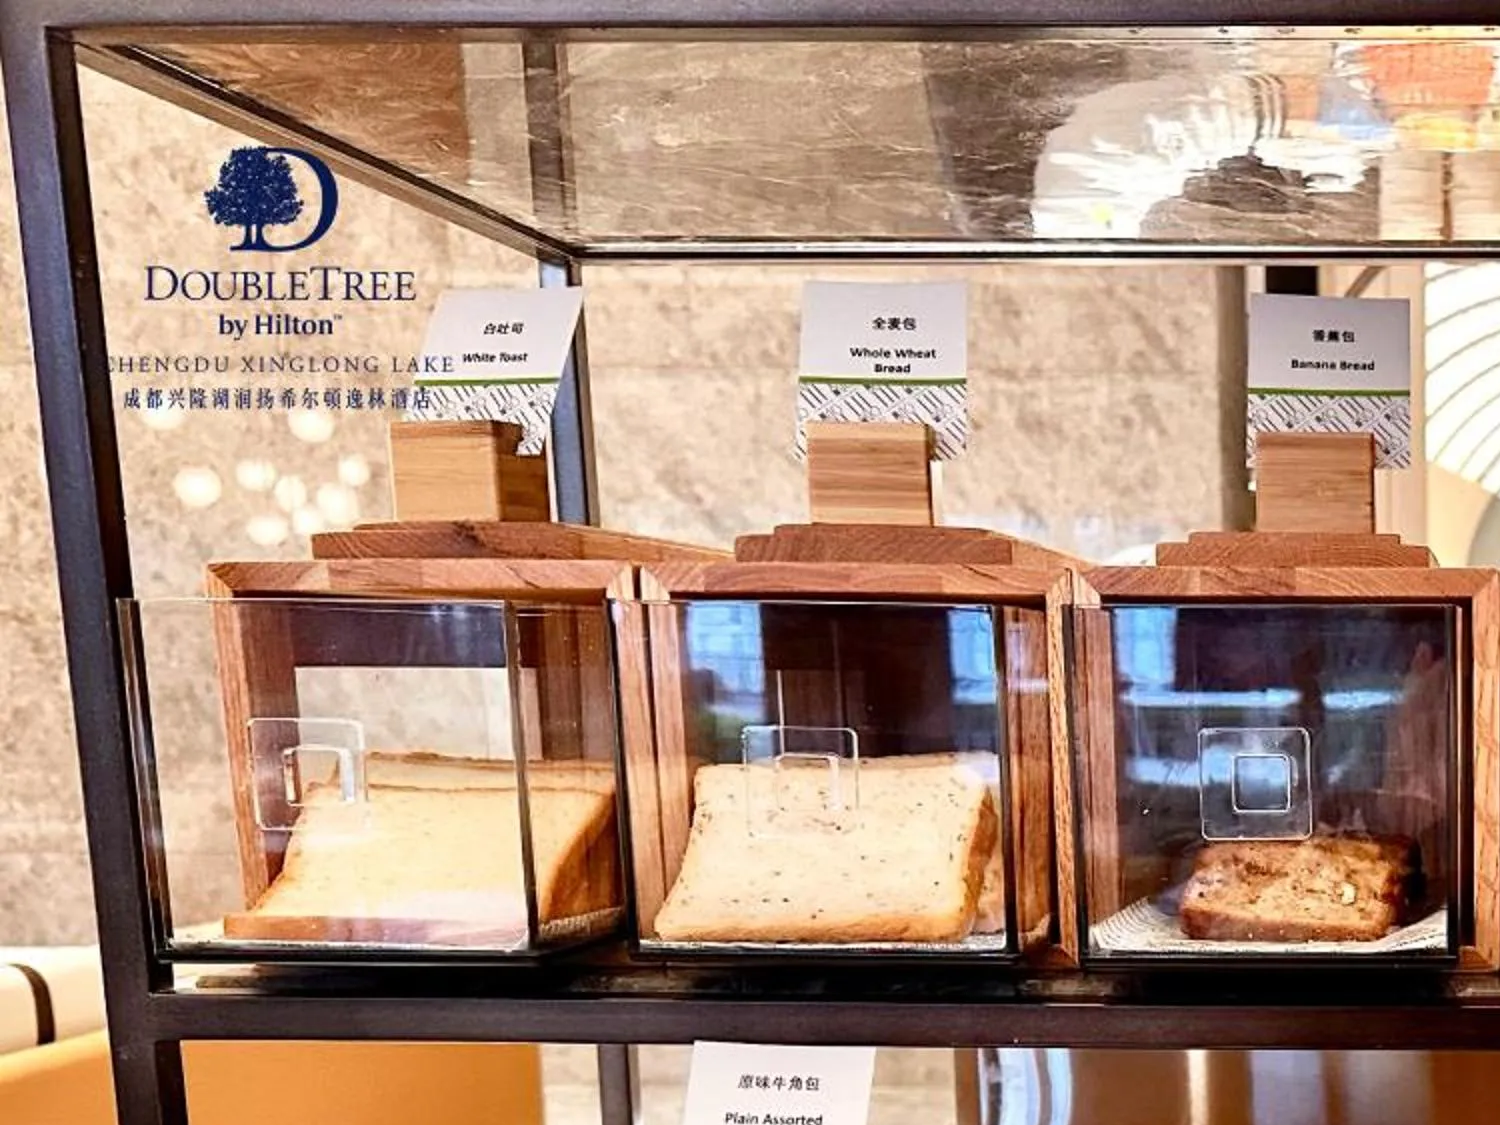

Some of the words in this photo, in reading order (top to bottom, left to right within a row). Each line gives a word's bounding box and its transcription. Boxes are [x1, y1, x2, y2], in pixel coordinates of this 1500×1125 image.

[483, 322, 524, 335] 白吐司
[872, 316, 917, 331] 全麦包
[1312, 329, 1356, 343] 香蕉包
[462, 352, 496, 363] White
[499, 352, 528, 363] Toast
[849, 347, 892, 359] Whole
[894, 347, 937, 359] Wheat
[873, 363, 911, 374] Bread
[1291, 358, 1338, 371] Banana
[1339, 360, 1375, 372] Bread
[737, 1073, 821, 1092] 原味牛角包
[724, 1111, 760, 1125] Plain
